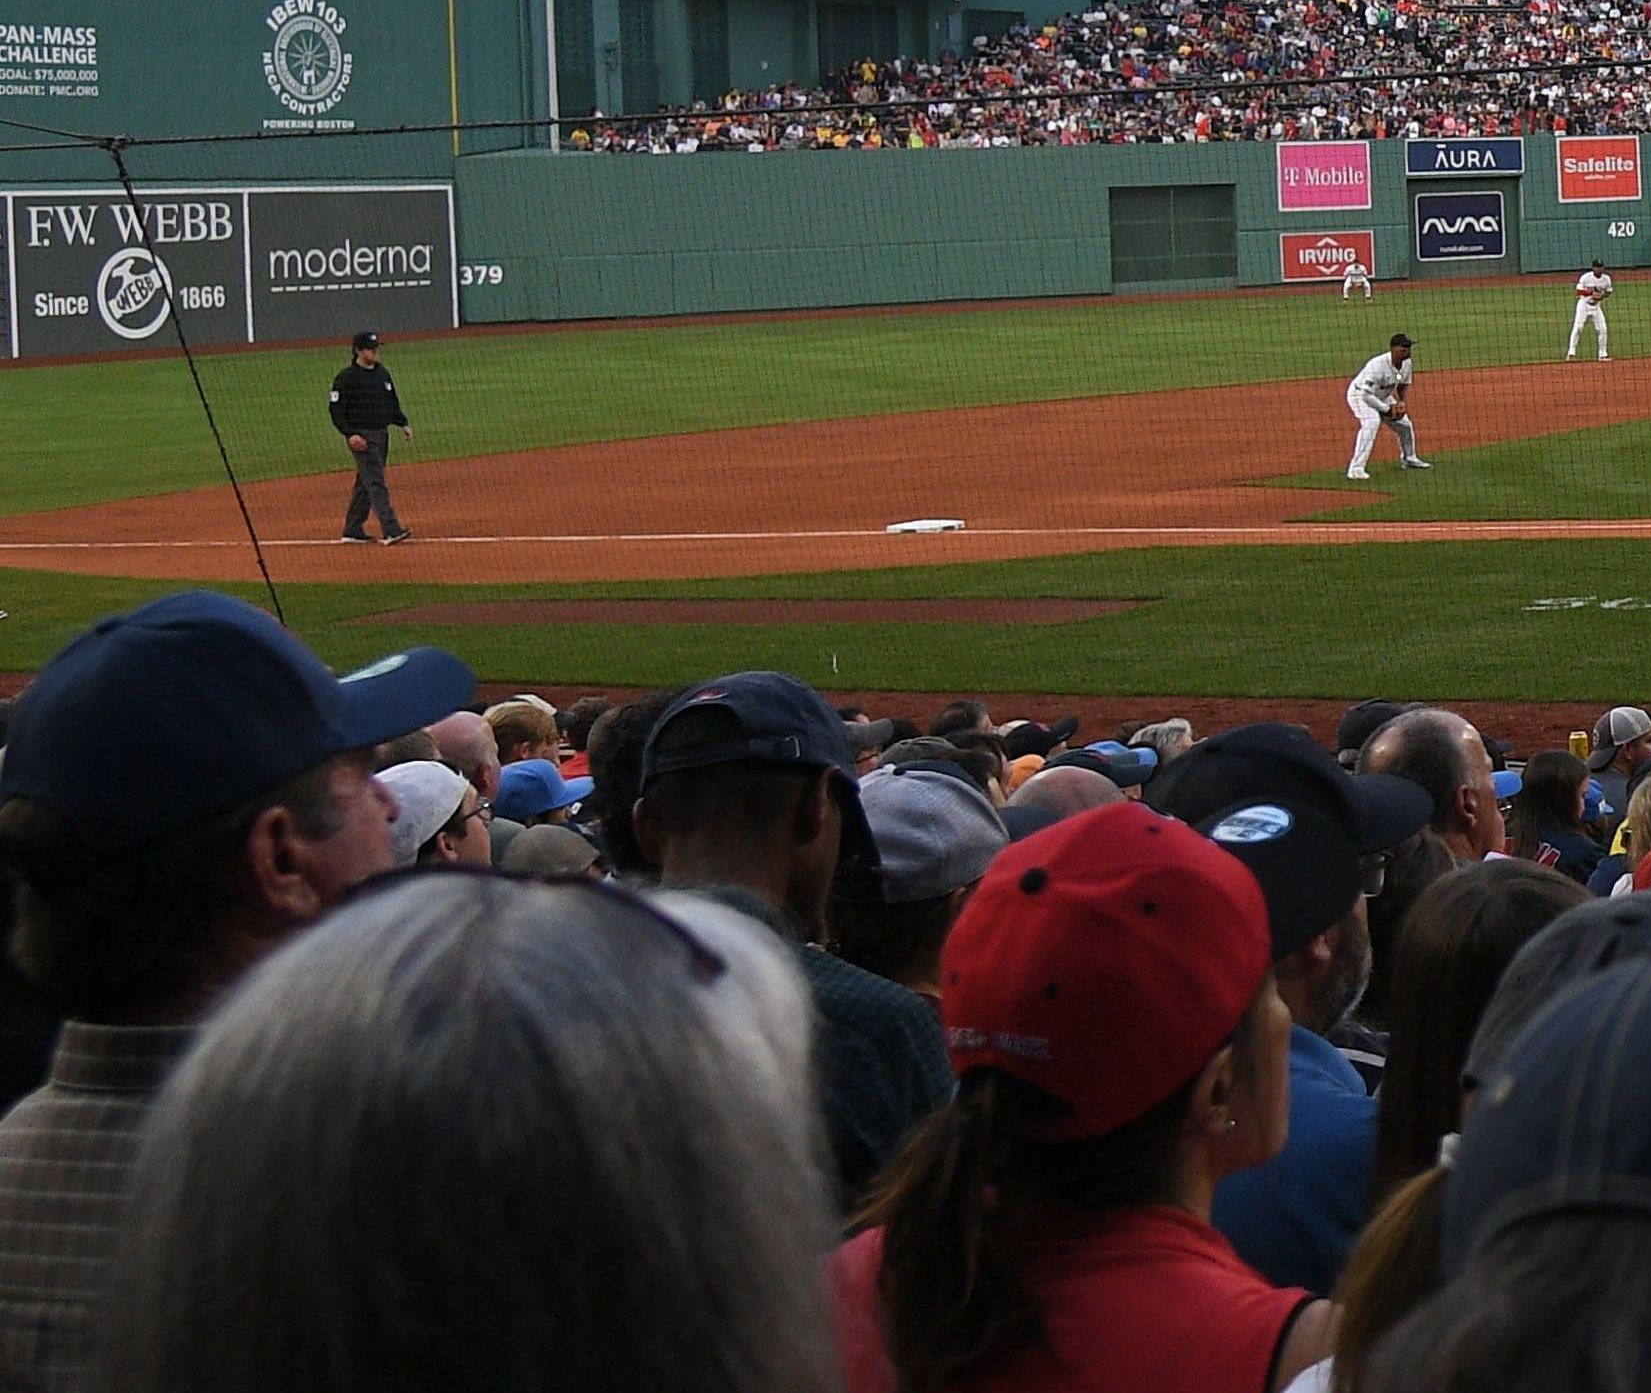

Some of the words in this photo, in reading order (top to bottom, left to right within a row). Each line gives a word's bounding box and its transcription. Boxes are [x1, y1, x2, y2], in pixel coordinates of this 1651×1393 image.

[316, 1, 347, 35] 103
[0, 25, 97, 47] PAN-MASS
[0, 46, 98, 66] CHALLENGE
[34, 68, 99, 82] $75,000,000
[262, 51, 282, 96] NECA
[281, 53, 353, 116] CONTRACTORS
[49, 85, 99, 97] PMC.ORG
[1304, 165, 1364, 187] Mobile
[1563, 156, 1635, 175] Safelite
[27, 204, 98, 248] F.W.
[113, 202, 235, 245] WEBB
[1421, 215, 1500, 235] nuna
[1607, 221, 1636, 238] 420
[269, 239, 434, 282] moderna
[1298, 247, 1357, 265] IRVING
[459, 265, 504, 287] 379
[34, 291, 89, 318] Since
[179, 284, 226, 310] 1866
[116, 273, 157, 315] WEBB
